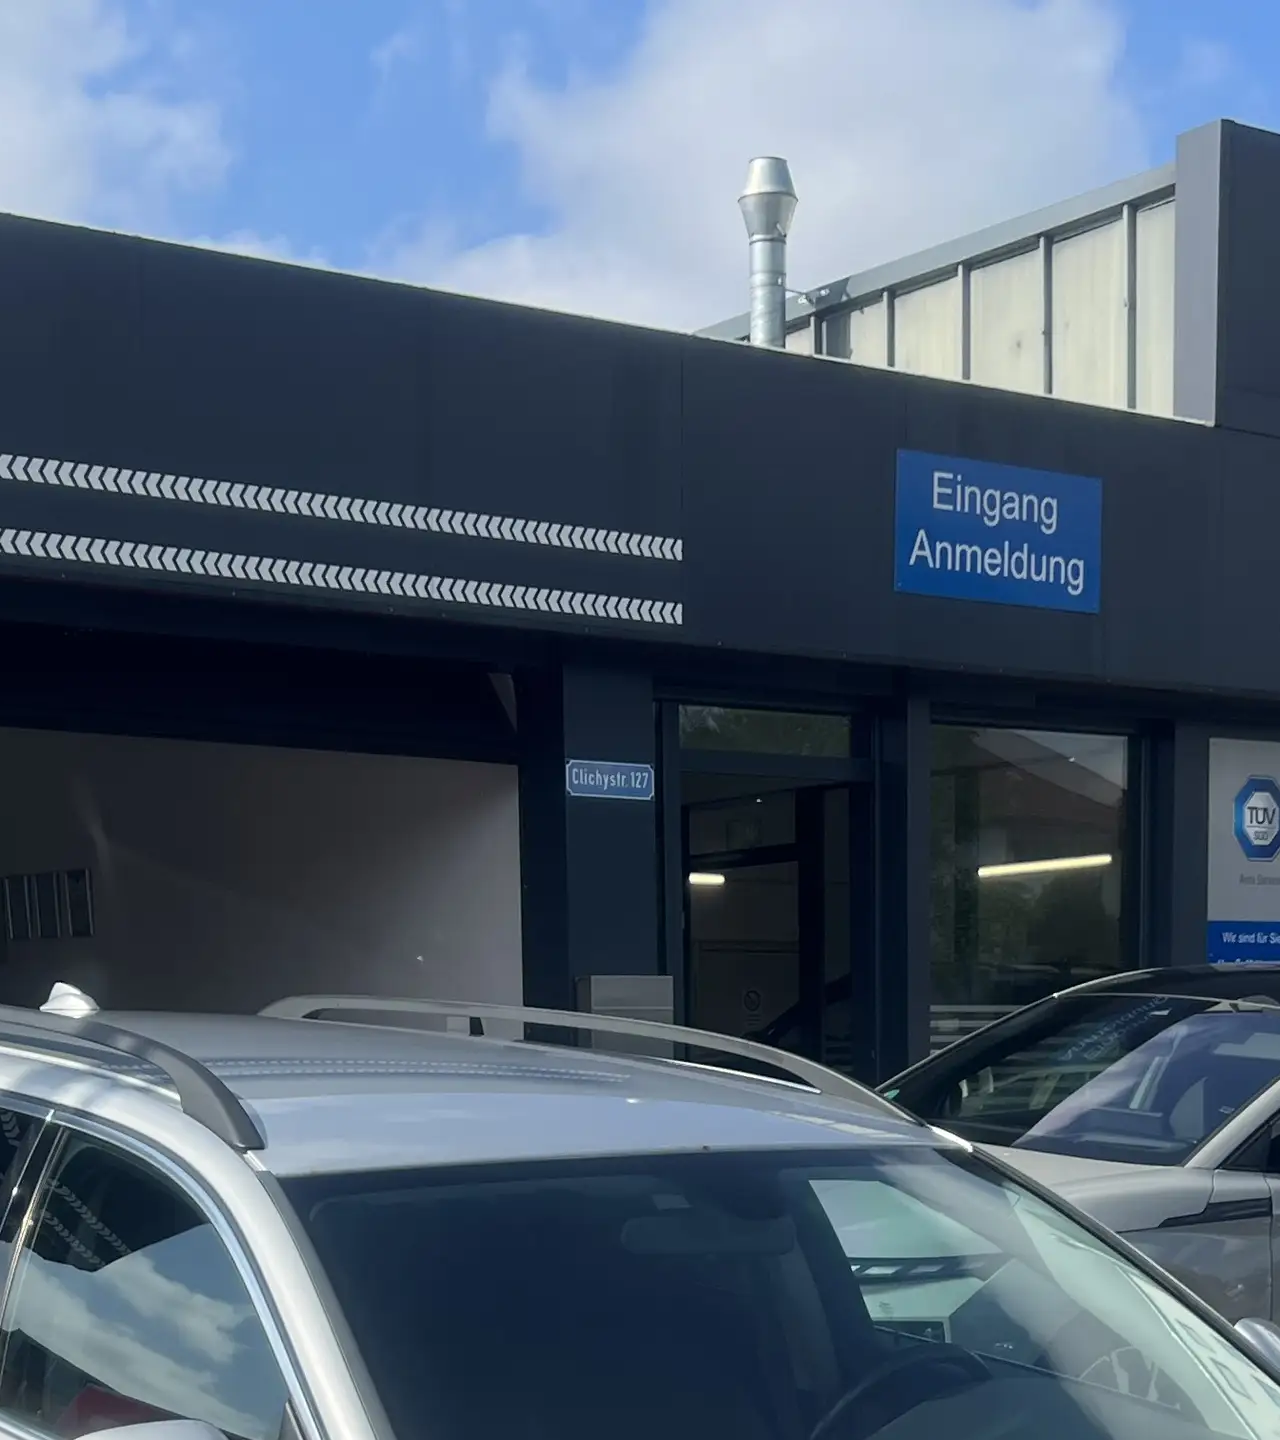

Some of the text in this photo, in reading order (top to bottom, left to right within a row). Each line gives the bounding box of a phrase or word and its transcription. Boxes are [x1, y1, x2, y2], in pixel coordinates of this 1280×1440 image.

[932, 470, 1058, 534] Eingang
[909, 529, 1085, 595] Anmeldung
[630, 771, 649, 788] 127
[1247, 806, 1276, 824] TÜV
